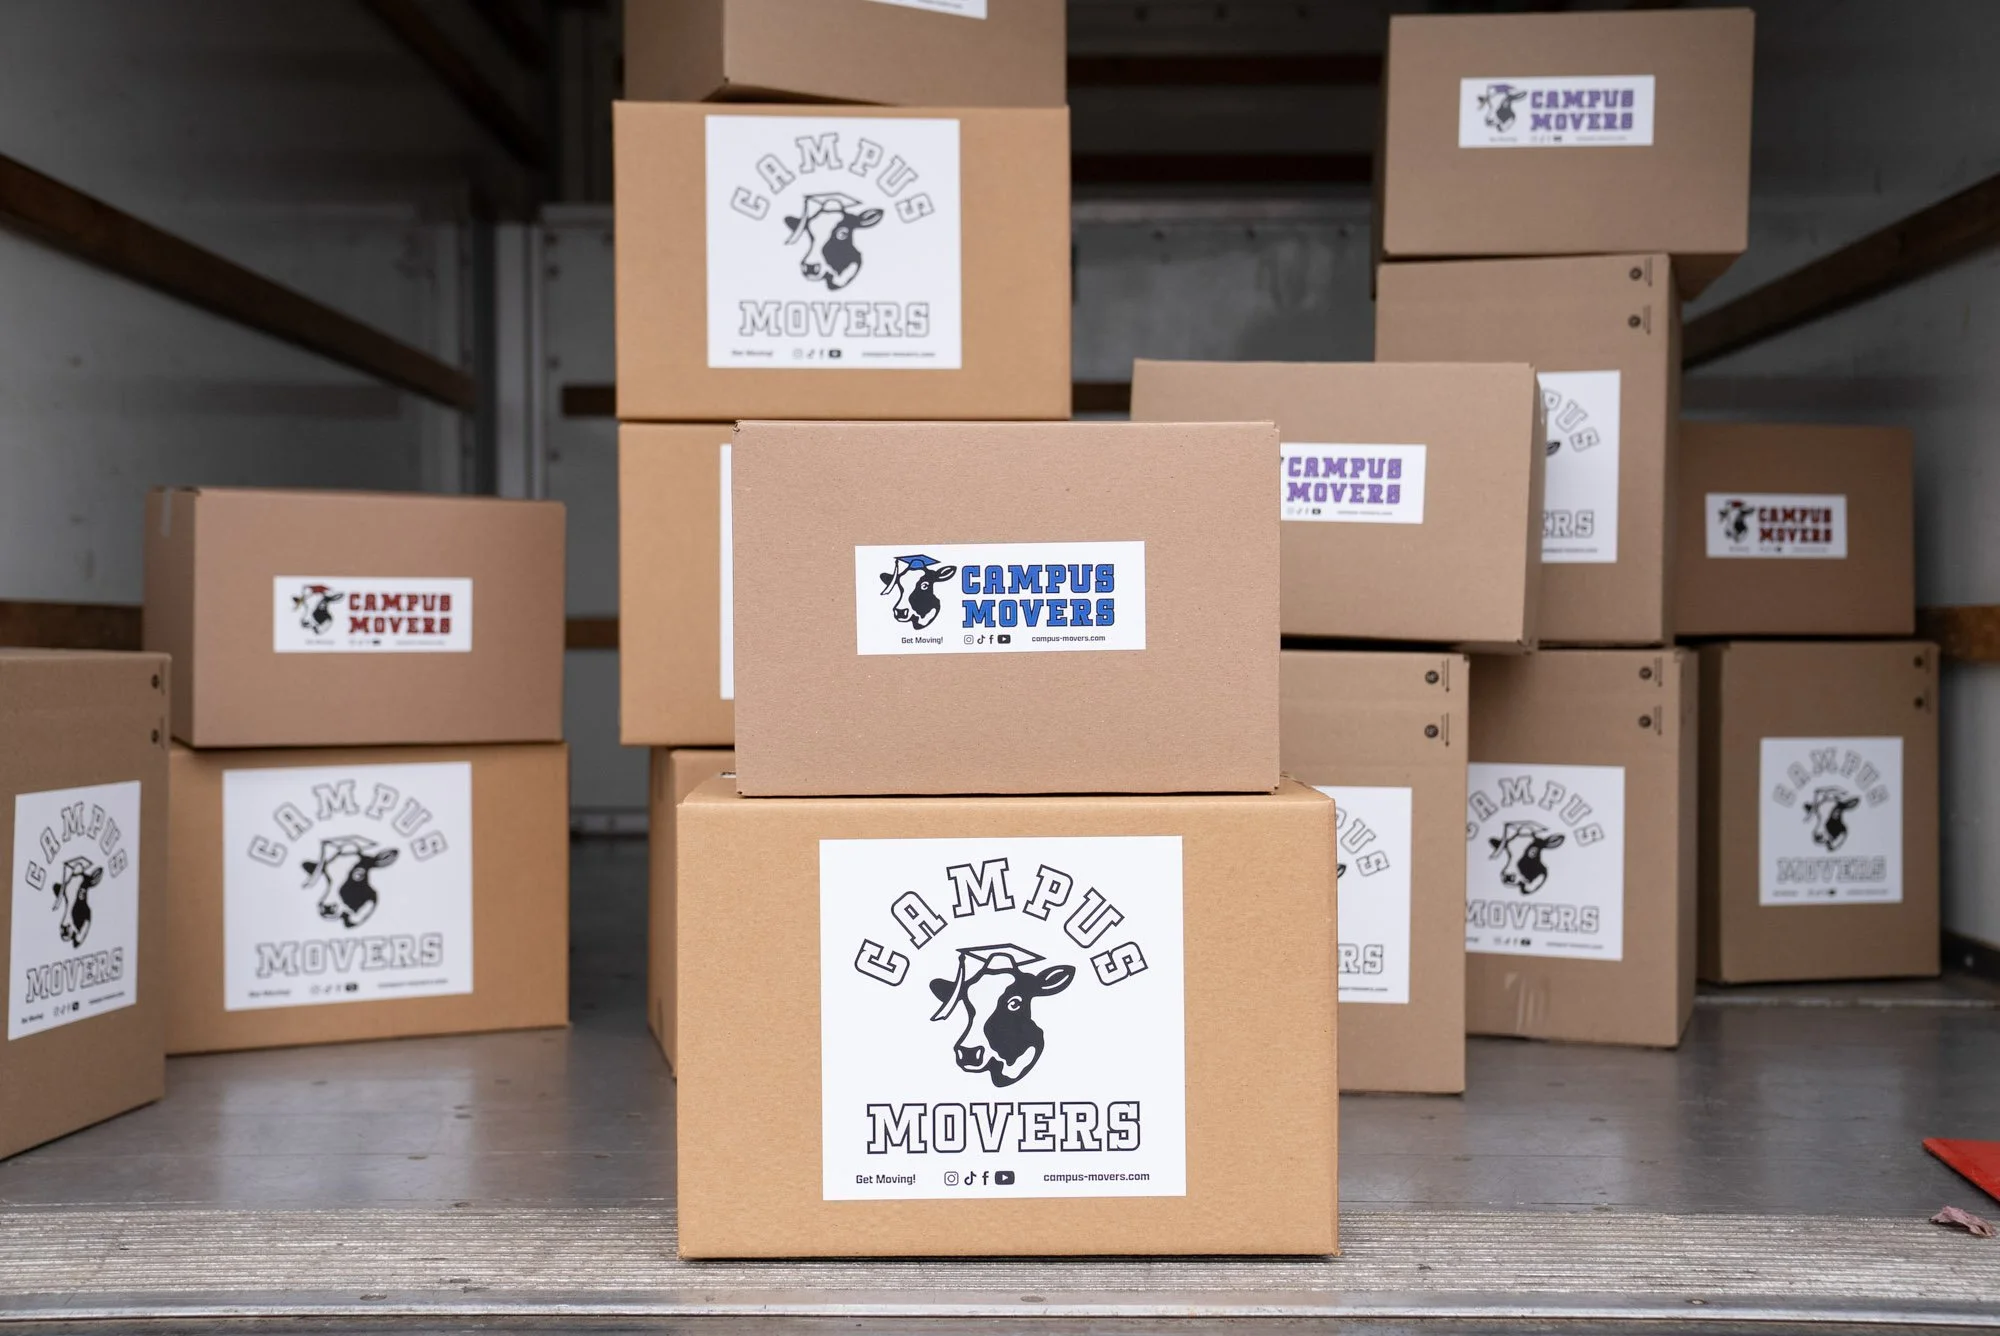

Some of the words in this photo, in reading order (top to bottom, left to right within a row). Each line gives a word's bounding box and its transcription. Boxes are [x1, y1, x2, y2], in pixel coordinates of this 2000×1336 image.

[1530, 89, 1635, 110] CAMPUS
[1530, 112, 1634, 131] MOVERS
[730, 132, 936, 224] CAMPUS
[738, 300, 930, 338] MOVERS
[1288, 456, 1403, 480] CAMPUS
[1287, 482, 1402, 505] MOVERS
[1758, 506, 1833, 524] CAMPUS
[961, 563, 1116, 595] CAMPUS
[348, 592, 453, 612] CAMPUS
[961, 597, 1116, 629] MOVERS
[348, 616, 452, 635] MOVERS
[1031, 635, 1106, 644] campus-movers.com
[901, 636, 913, 645] Get
[914, 635, 944, 646] Moving!
[1771, 747, 1890, 809] CAMPUS
[246, 778, 449, 868] CAMPUS
[24, 800, 129, 892] CAMPUS
[854, 856, 1149, 987] CAMPUS
[255, 931, 444, 980] MOVERS
[25, 947, 124, 1004] MOVERS
[866, 1100, 1141, 1155] MOVERS
[855, 1173, 874, 1185] Get
[875, 1173, 917, 1186] Moving!
[1043, 1171, 1151, 1184] campus-movers.com
